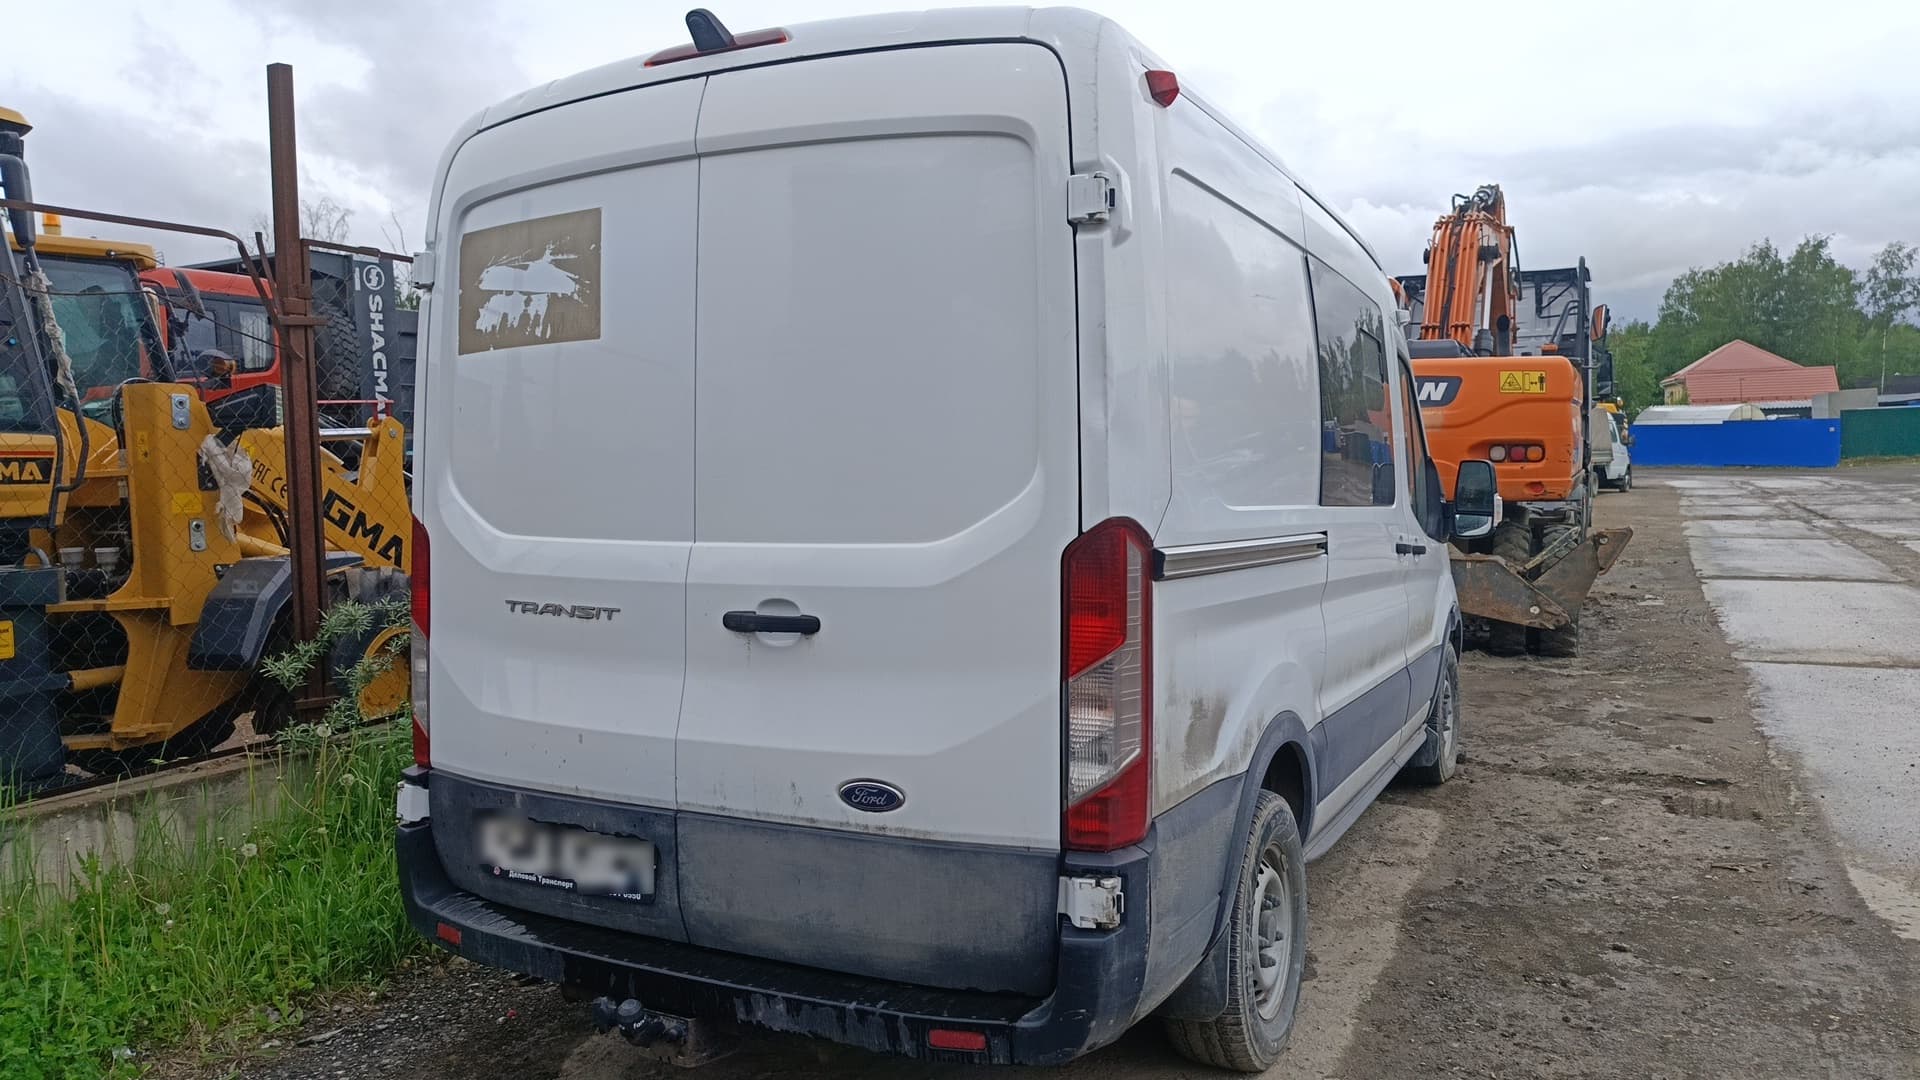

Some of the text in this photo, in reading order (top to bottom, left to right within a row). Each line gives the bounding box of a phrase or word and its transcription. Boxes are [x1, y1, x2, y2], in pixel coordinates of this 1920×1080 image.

[369, 293, 389, 420] SHACMA
[0, 461, 43, 481] MA
[323, 488, 404, 568] GMA
[505, 599, 621, 621] TRANSIT
[851, 786, 888, 806] Ford
[537, 875, 574, 889] Транспорт
